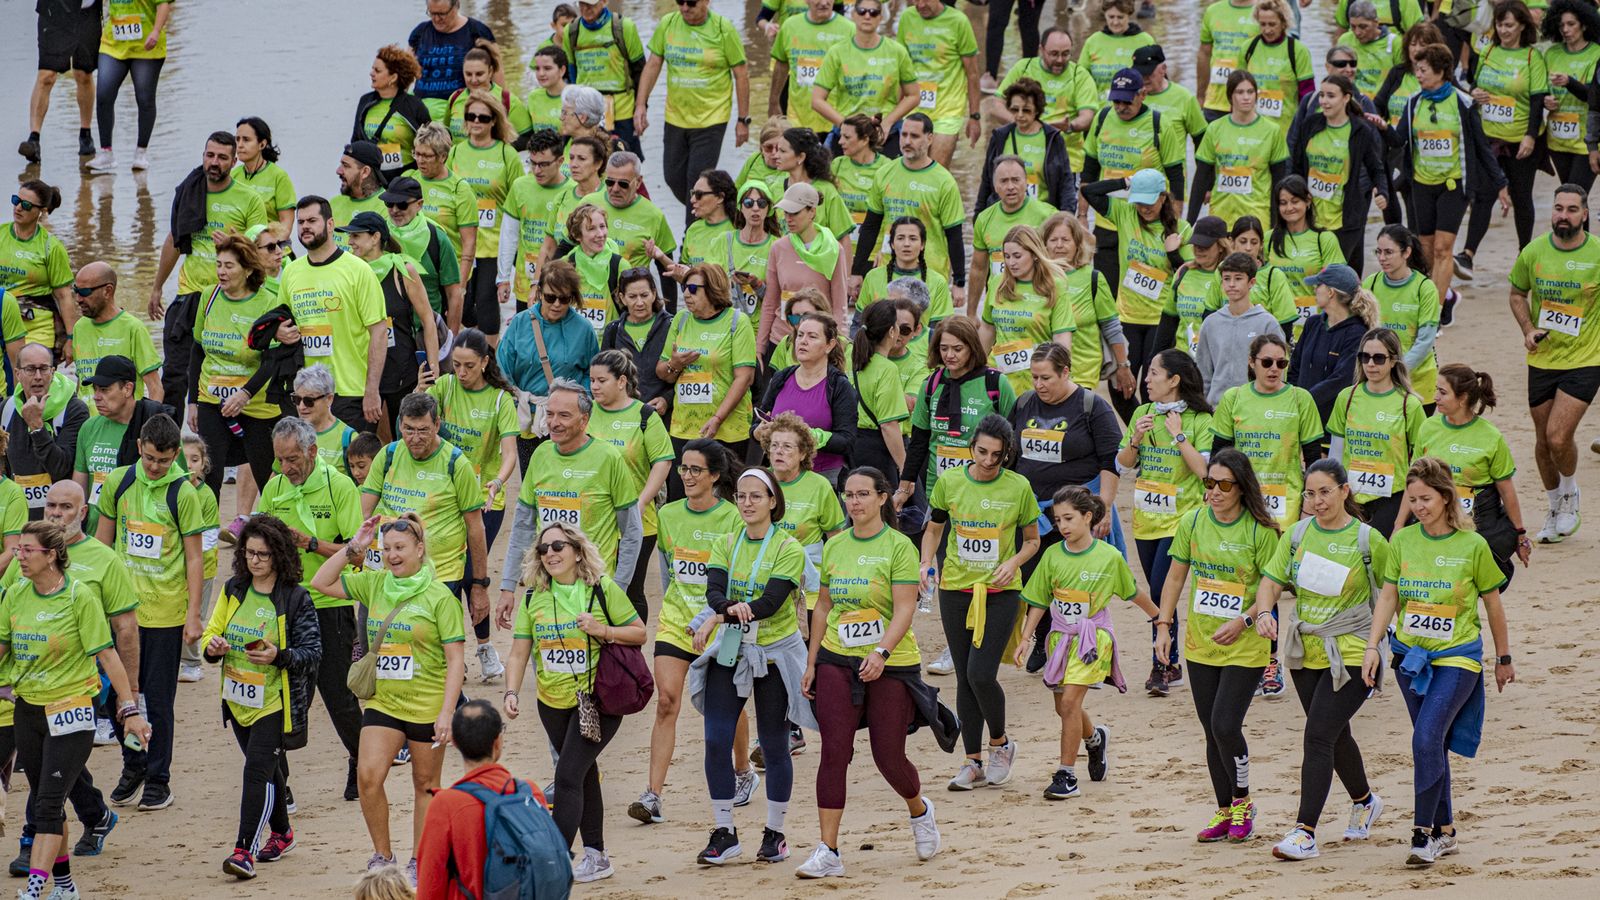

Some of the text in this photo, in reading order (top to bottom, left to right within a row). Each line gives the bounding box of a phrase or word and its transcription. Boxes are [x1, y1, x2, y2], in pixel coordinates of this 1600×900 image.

[115, 23, 141, 35] 3118
[1485, 103, 1513, 117] 3758
[1552, 121, 1577, 132] 3757
[1422, 138, 1450, 150] 2863
[463, 177, 490, 185] archa
[1221, 175, 1249, 188] 2067
[1134, 273, 1158, 292] 860
[1546, 280, 1581, 289] marcha
[303, 290, 333, 299] marcha
[1002, 309, 1033, 317] marcha
[1546, 310, 1579, 329] 2671
[1003, 350, 1028, 366] 629
[680, 383, 710, 396] 3694
[938, 422, 970, 433] cáer
[1245, 431, 1280, 440] marcha
[1356, 431, 1390, 441] marcha
[1026, 440, 1060, 455] 4544
[1358, 473, 1386, 488] 443
[384, 483, 426, 498] En marcha
[544, 490, 578, 498] marcha
[1144, 492, 1170, 507] 441
[542, 508, 578, 524] 2088
[961, 521, 997, 529] marcha
[963, 539, 992, 553] 409
[1200, 562, 1235, 575] marcha
[835, 577, 869, 586] marcha
[1399, 577, 1452, 589] En marcha
[1399, 589, 1430, 598] contra
[1200, 591, 1241, 611] 2562
[535, 621, 578, 632] En march
[844, 620, 881, 639] 1221
[1409, 614, 1453, 632] 2465
[15, 632, 48, 642] marcha
[230, 623, 264, 638] marcha
[375, 656, 412, 671] 4297
[546, 650, 586, 664] 4298
[231, 680, 256, 699] 718
[54, 706, 93, 728] 4065
